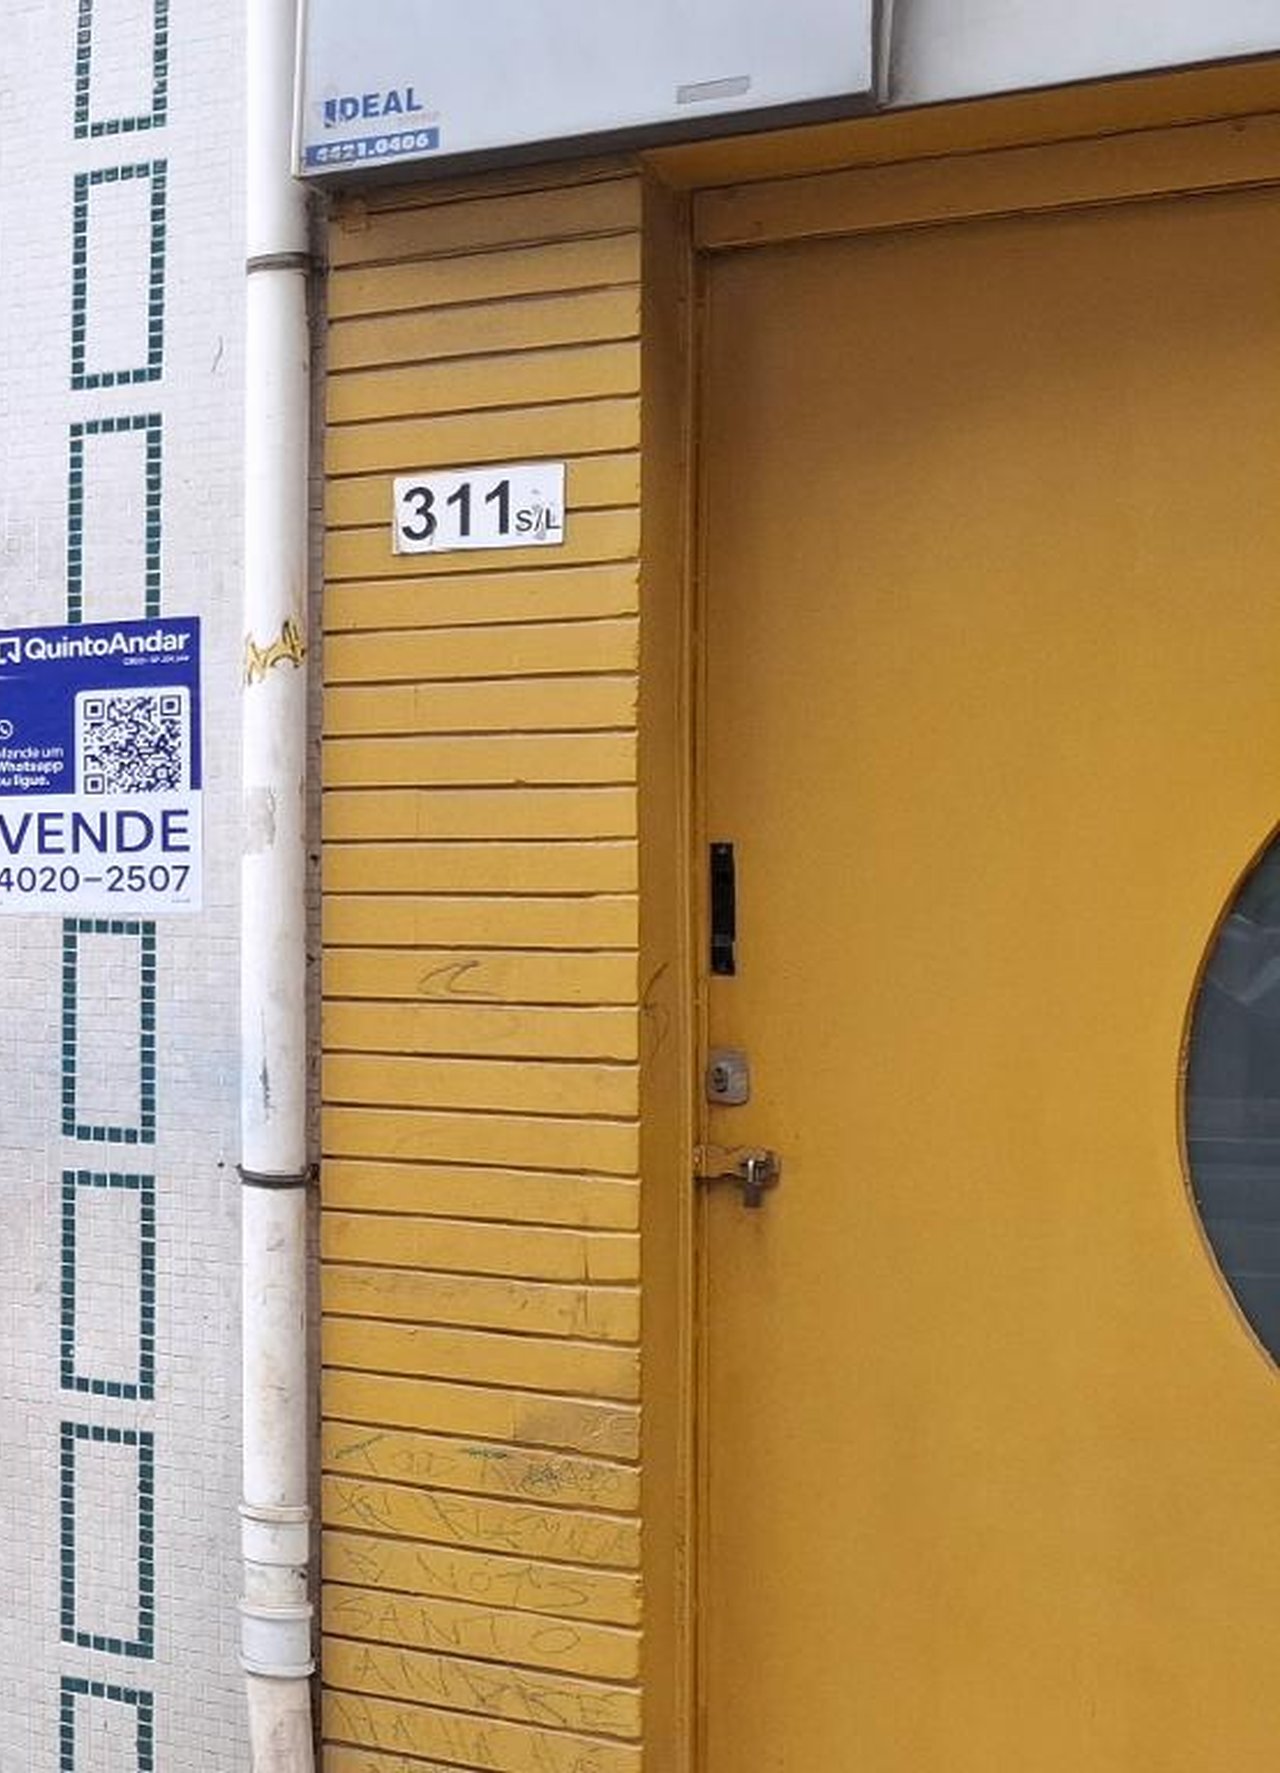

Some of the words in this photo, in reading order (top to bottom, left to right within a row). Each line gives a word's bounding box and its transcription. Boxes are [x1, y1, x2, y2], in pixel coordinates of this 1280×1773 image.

[324, 87, 423, 128] IDEAL
[401, 479, 510, 541] 311
[515, 507, 562, 533] S/L
[25, 630, 191, 660] QuintoAndar
[42, 747, 64, 759] um
